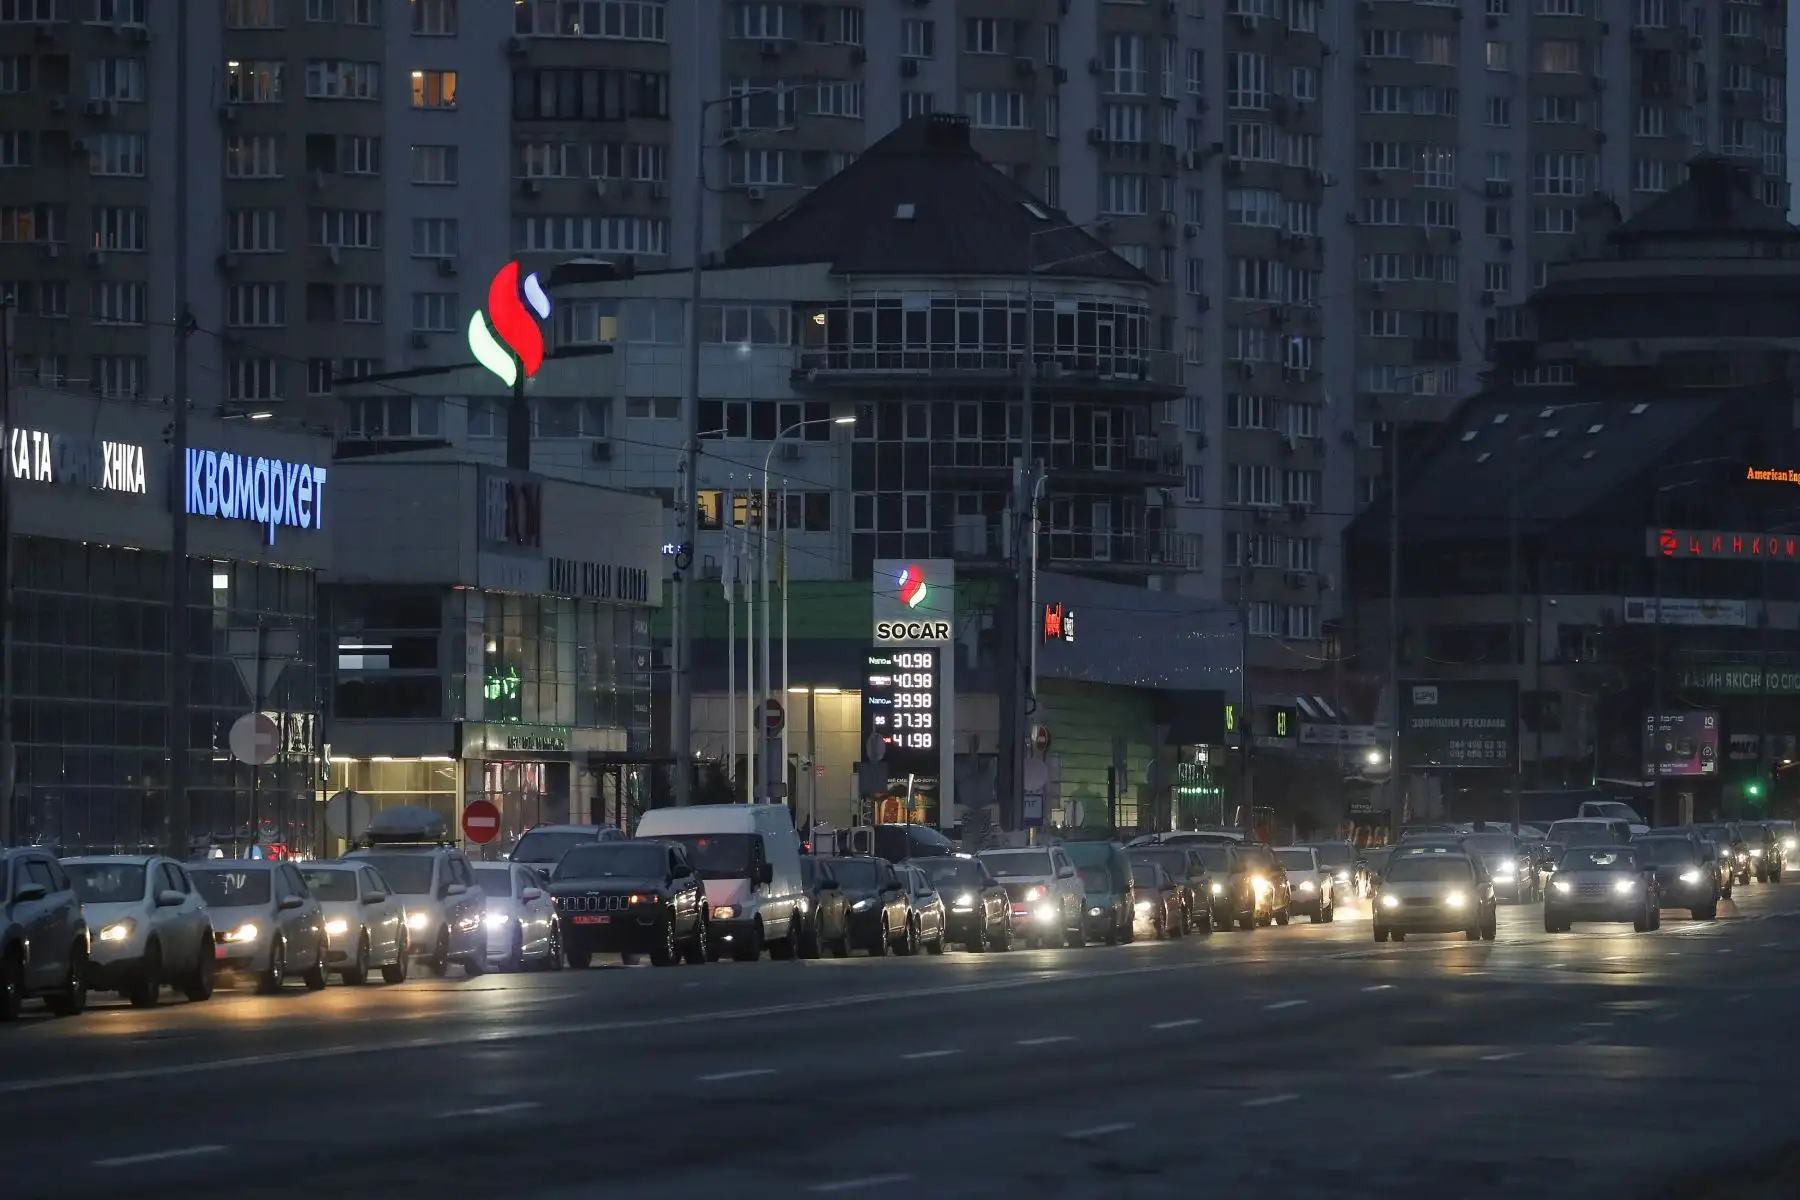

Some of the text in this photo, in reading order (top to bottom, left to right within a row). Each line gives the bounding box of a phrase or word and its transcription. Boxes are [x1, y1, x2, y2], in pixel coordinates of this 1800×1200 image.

[33, 430, 52, 482] ТА
[1746, 466, 1788, 481] American
[876, 622, 949, 640] SOCAR
[893, 653, 932, 669] 40.98
[893, 673, 932, 688] 40.98
[893, 693, 932, 708] 39.98
[893, 713, 932, 728] 37.39
[892, 733, 932, 748] 41.98
